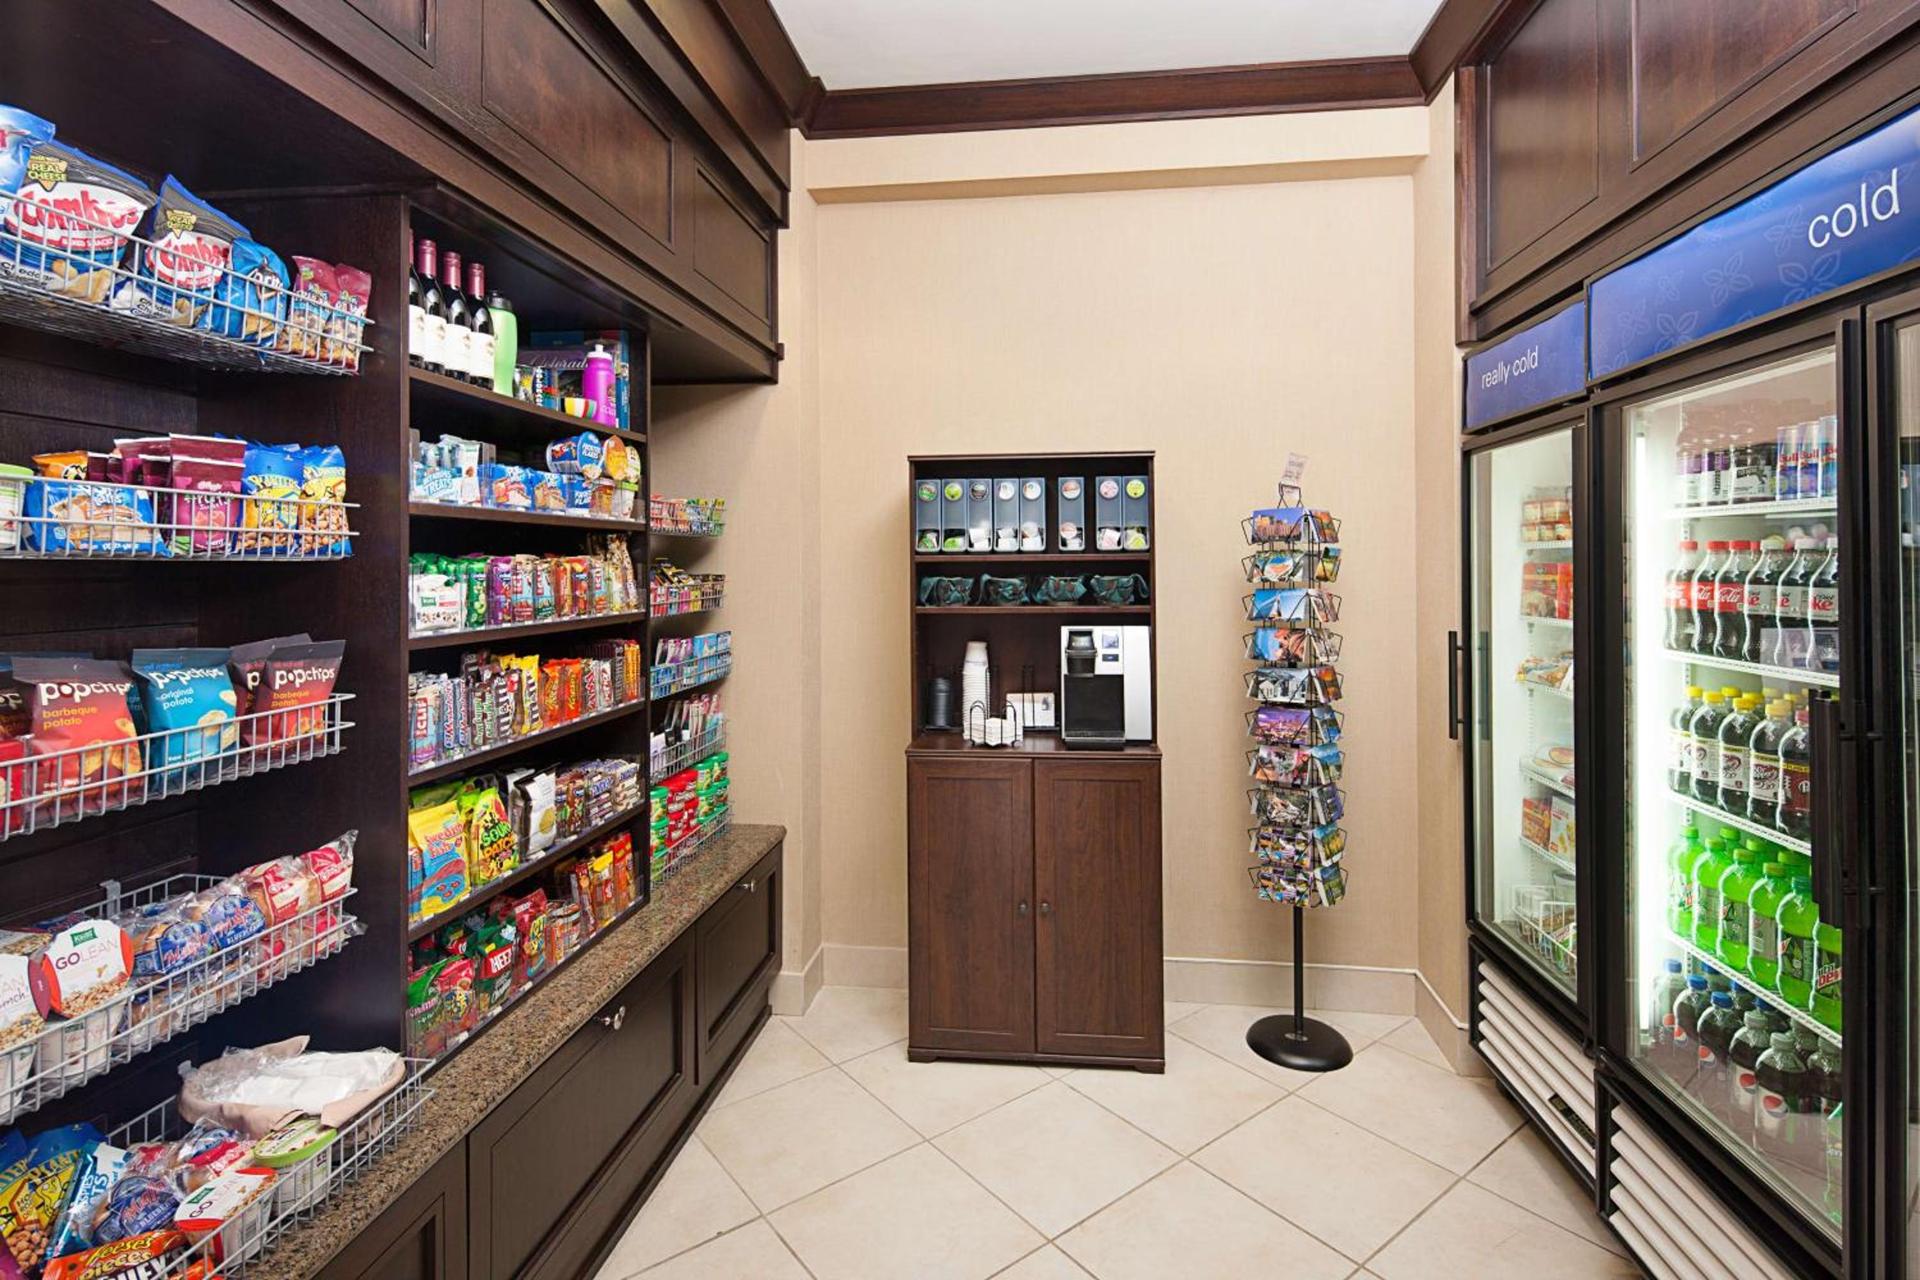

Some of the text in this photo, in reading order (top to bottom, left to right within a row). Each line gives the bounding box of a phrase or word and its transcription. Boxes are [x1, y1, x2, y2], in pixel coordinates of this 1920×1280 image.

[1807, 167, 1901, 248] cold
[1481, 345, 1539, 391] really cold
[1811, 596, 1834, 611] ke
[148, 667, 225, 690] popchips
[274, 666, 336, 694] popchips
[160, 686, 194, 701] original
[273, 694, 310, 705] barbeque
[163, 697, 194, 711] potato
[42, 706, 97, 719] barbeque
[415, 697, 427, 738] CLIF
[43, 717, 82, 731] potato
